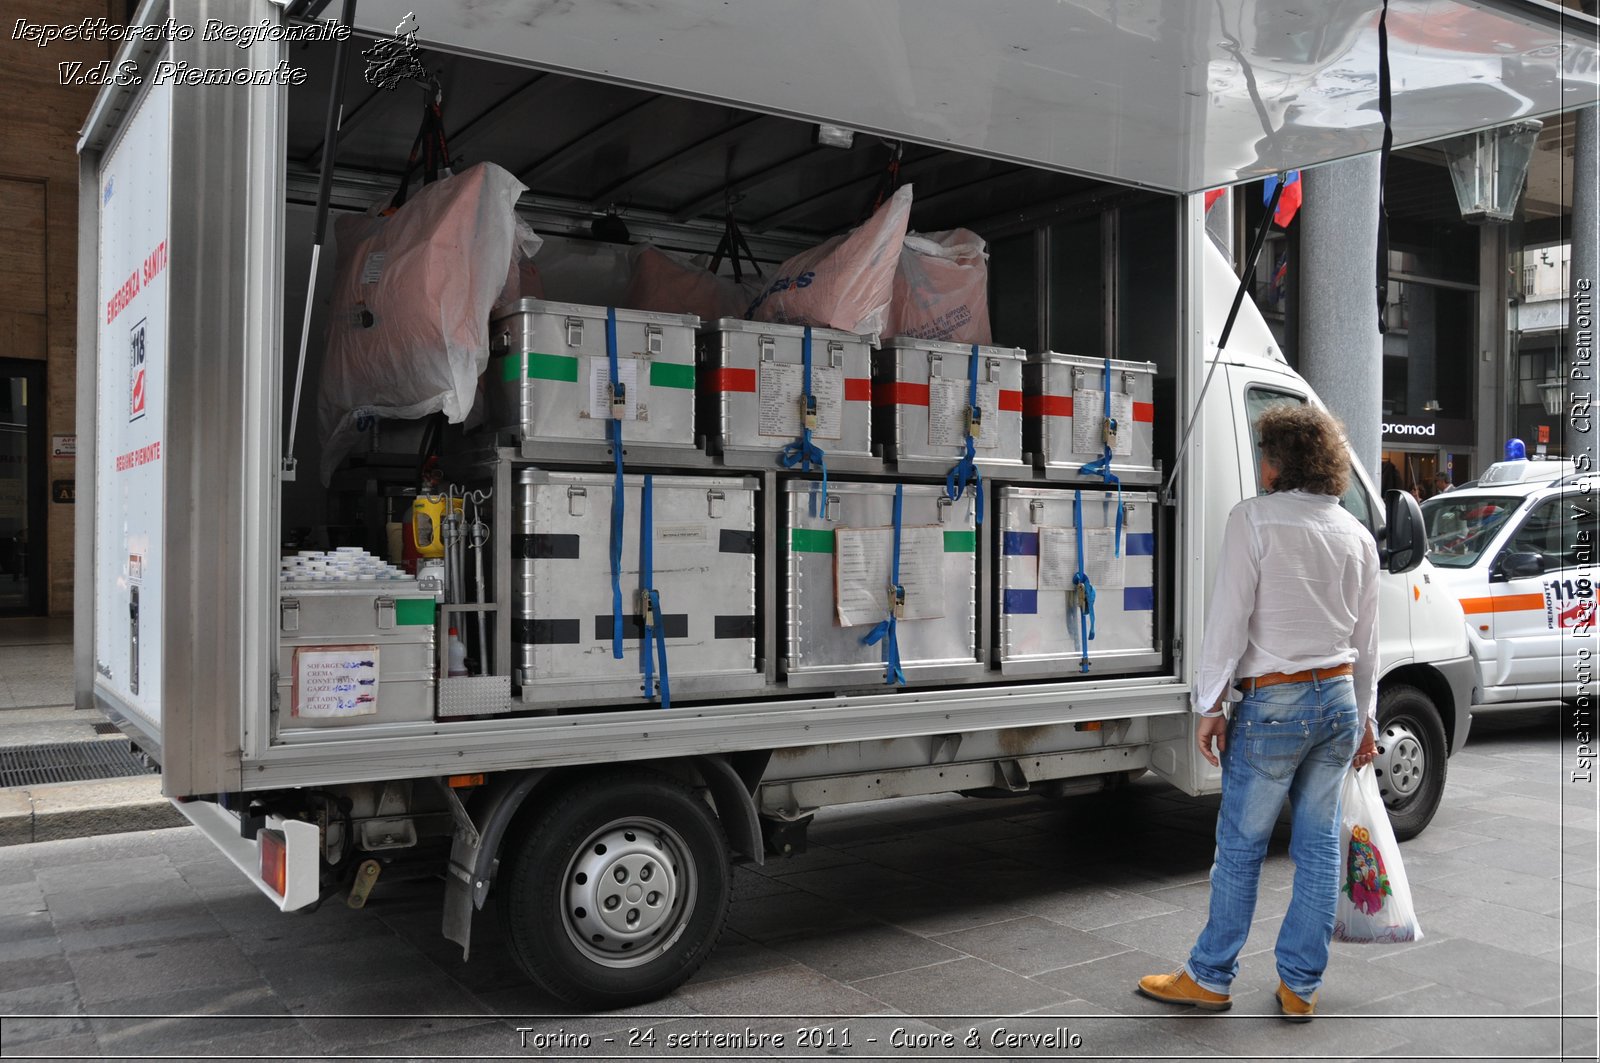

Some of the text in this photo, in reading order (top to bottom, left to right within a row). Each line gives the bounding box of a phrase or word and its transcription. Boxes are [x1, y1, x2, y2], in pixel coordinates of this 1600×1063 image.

[107, 268, 140, 325] EMERGENZA
[132, 327, 145, 367] 118
[135, 441, 160, 466] PIEMONTE
[1542, 580, 1554, 630] PIEMONTE
[1550, 579, 1594, 600] 118
